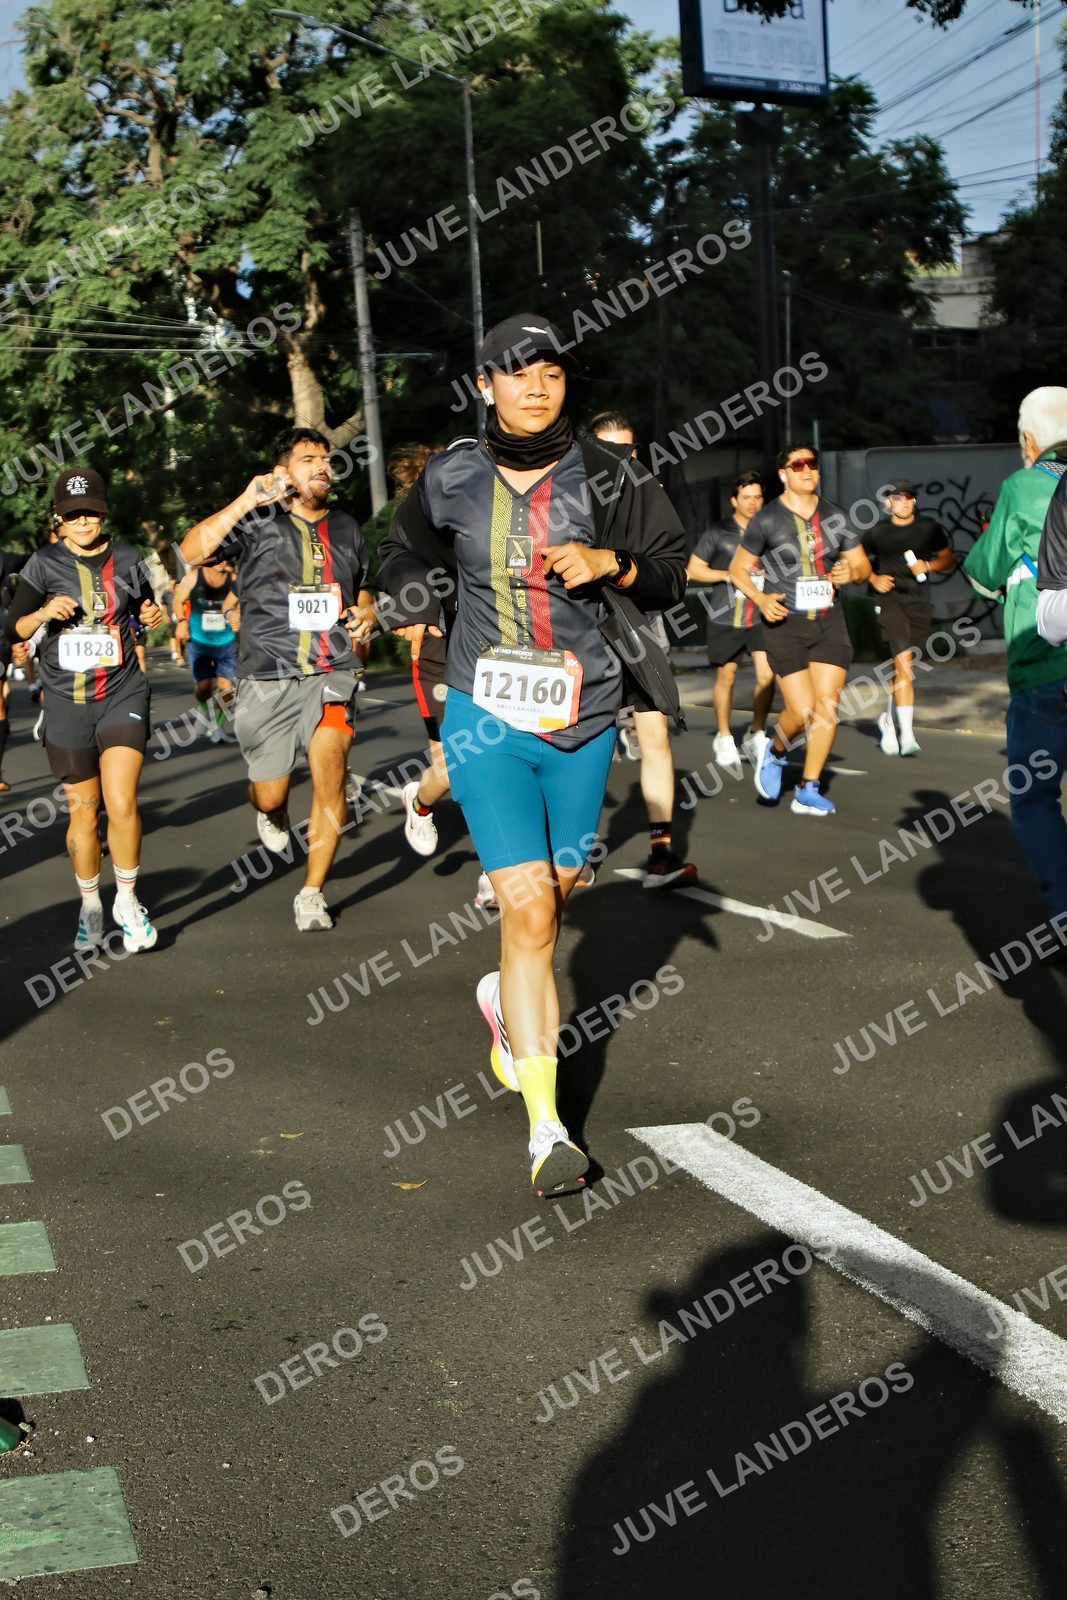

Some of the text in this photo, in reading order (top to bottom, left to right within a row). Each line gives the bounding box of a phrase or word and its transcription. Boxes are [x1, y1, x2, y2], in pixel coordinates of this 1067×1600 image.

[297, 599, 328, 613] 9021
[64, 641, 114, 656] 11828
[481, 670, 567, 706] 12160
